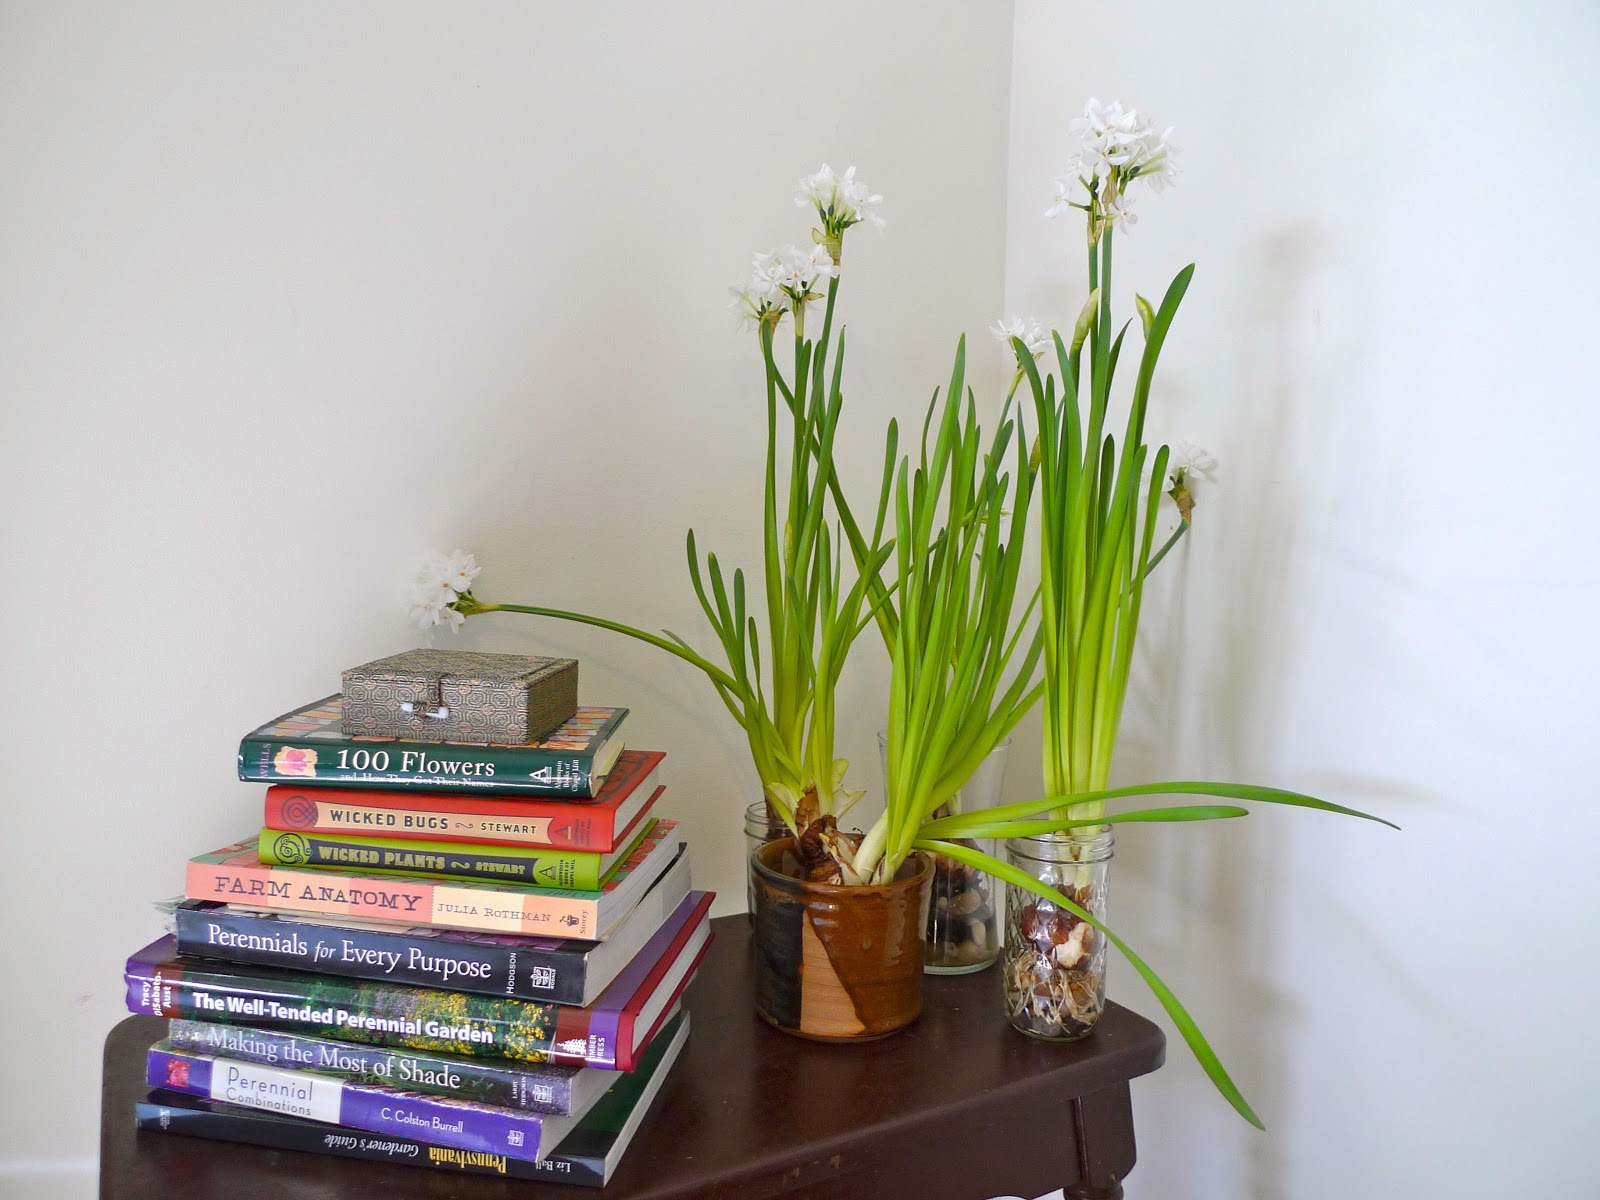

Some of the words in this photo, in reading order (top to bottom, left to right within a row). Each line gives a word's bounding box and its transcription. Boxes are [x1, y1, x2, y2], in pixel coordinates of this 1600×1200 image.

[260, 743, 272, 777] WELLS
[337, 749, 390, 771] 100
[400, 750, 495, 777] Flowers
[555, 760, 563, 789] Algnquin
[330, 809, 396, 827] WICKED
[404, 815, 449, 830] BUGS
[480, 822, 538, 835] STEWART
[317, 845, 380, 864] WICKED
[384, 852, 446, 870] PLANTS
[475, 861, 526, 876] STEWART
[214, 876, 292, 898] FARM
[299, 885, 423, 911] ANATOMY
[437, 903, 479, 915] JULIA
[579, 910, 589, 934] Storey
[207, 923, 308, 956] Perennials
[314, 941, 336, 963] for
[341, 940, 402, 973] Every
[407, 947, 492, 981] Purpose
[505, 952, 517, 994] HODGSON
[142, 981, 152, 1006] Tracy
[163, 985, 172, 1008] Aust
[192, 992, 225, 1010] The
[226, 996, 333, 1024] Well-Tended
[336, 1009, 422, 1035] Perennial
[425, 1021, 493, 1044] Garden
[208, 1027, 278, 1062] Making
[283, 1039, 313, 1064] the
[319, 1045, 367, 1073] Most
[373, 1056, 396, 1077] of
[400, 1058, 461, 1089] Shade
[588, 1034, 597, 1061] IMBER
[228, 1066, 314, 1101] Perennial
[226, 1087, 312, 1116] Combinations
[381, 1107, 393, 1121] C.
[395, 1110, 430, 1128] Colston
[432, 1116, 464, 1134] Burrell
[324, 1134, 358, 1150] Guide
[359, 1138, 419, 1157] Gardener's
[429, 1146, 508, 1174] Pennsylvania
[556, 1162, 571, 1173] Liz
